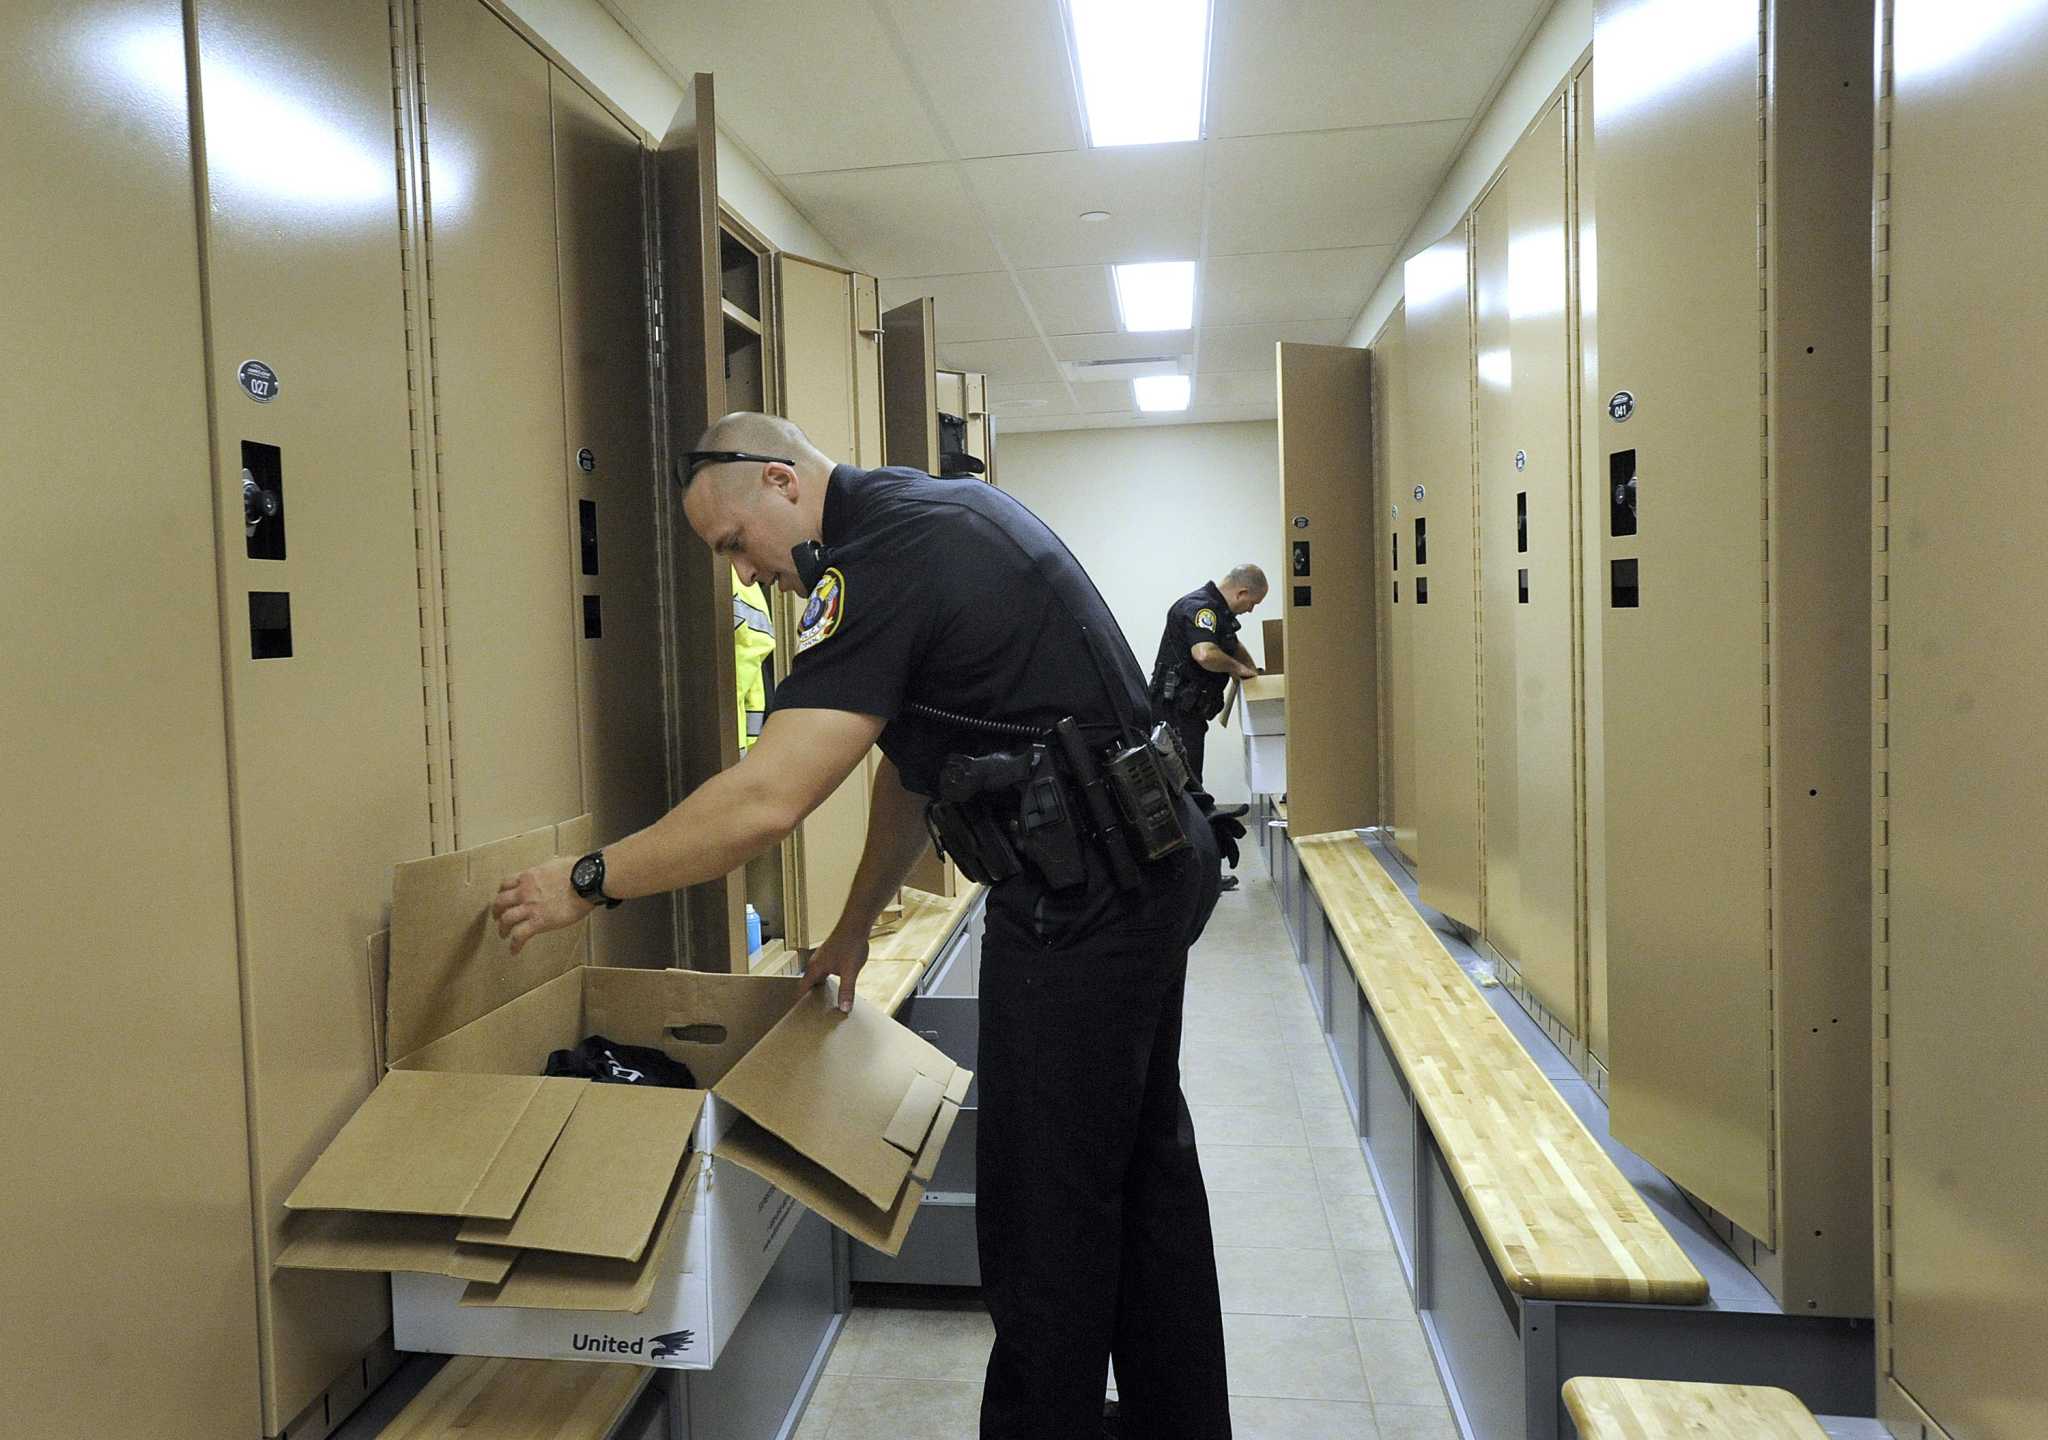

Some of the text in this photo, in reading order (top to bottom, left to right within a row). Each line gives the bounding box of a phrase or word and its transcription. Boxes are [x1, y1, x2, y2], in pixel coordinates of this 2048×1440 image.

[250, 379, 269, 396] 027
[1614, 404, 1627, 418] 041
[572, 1333, 644, 1355] United
